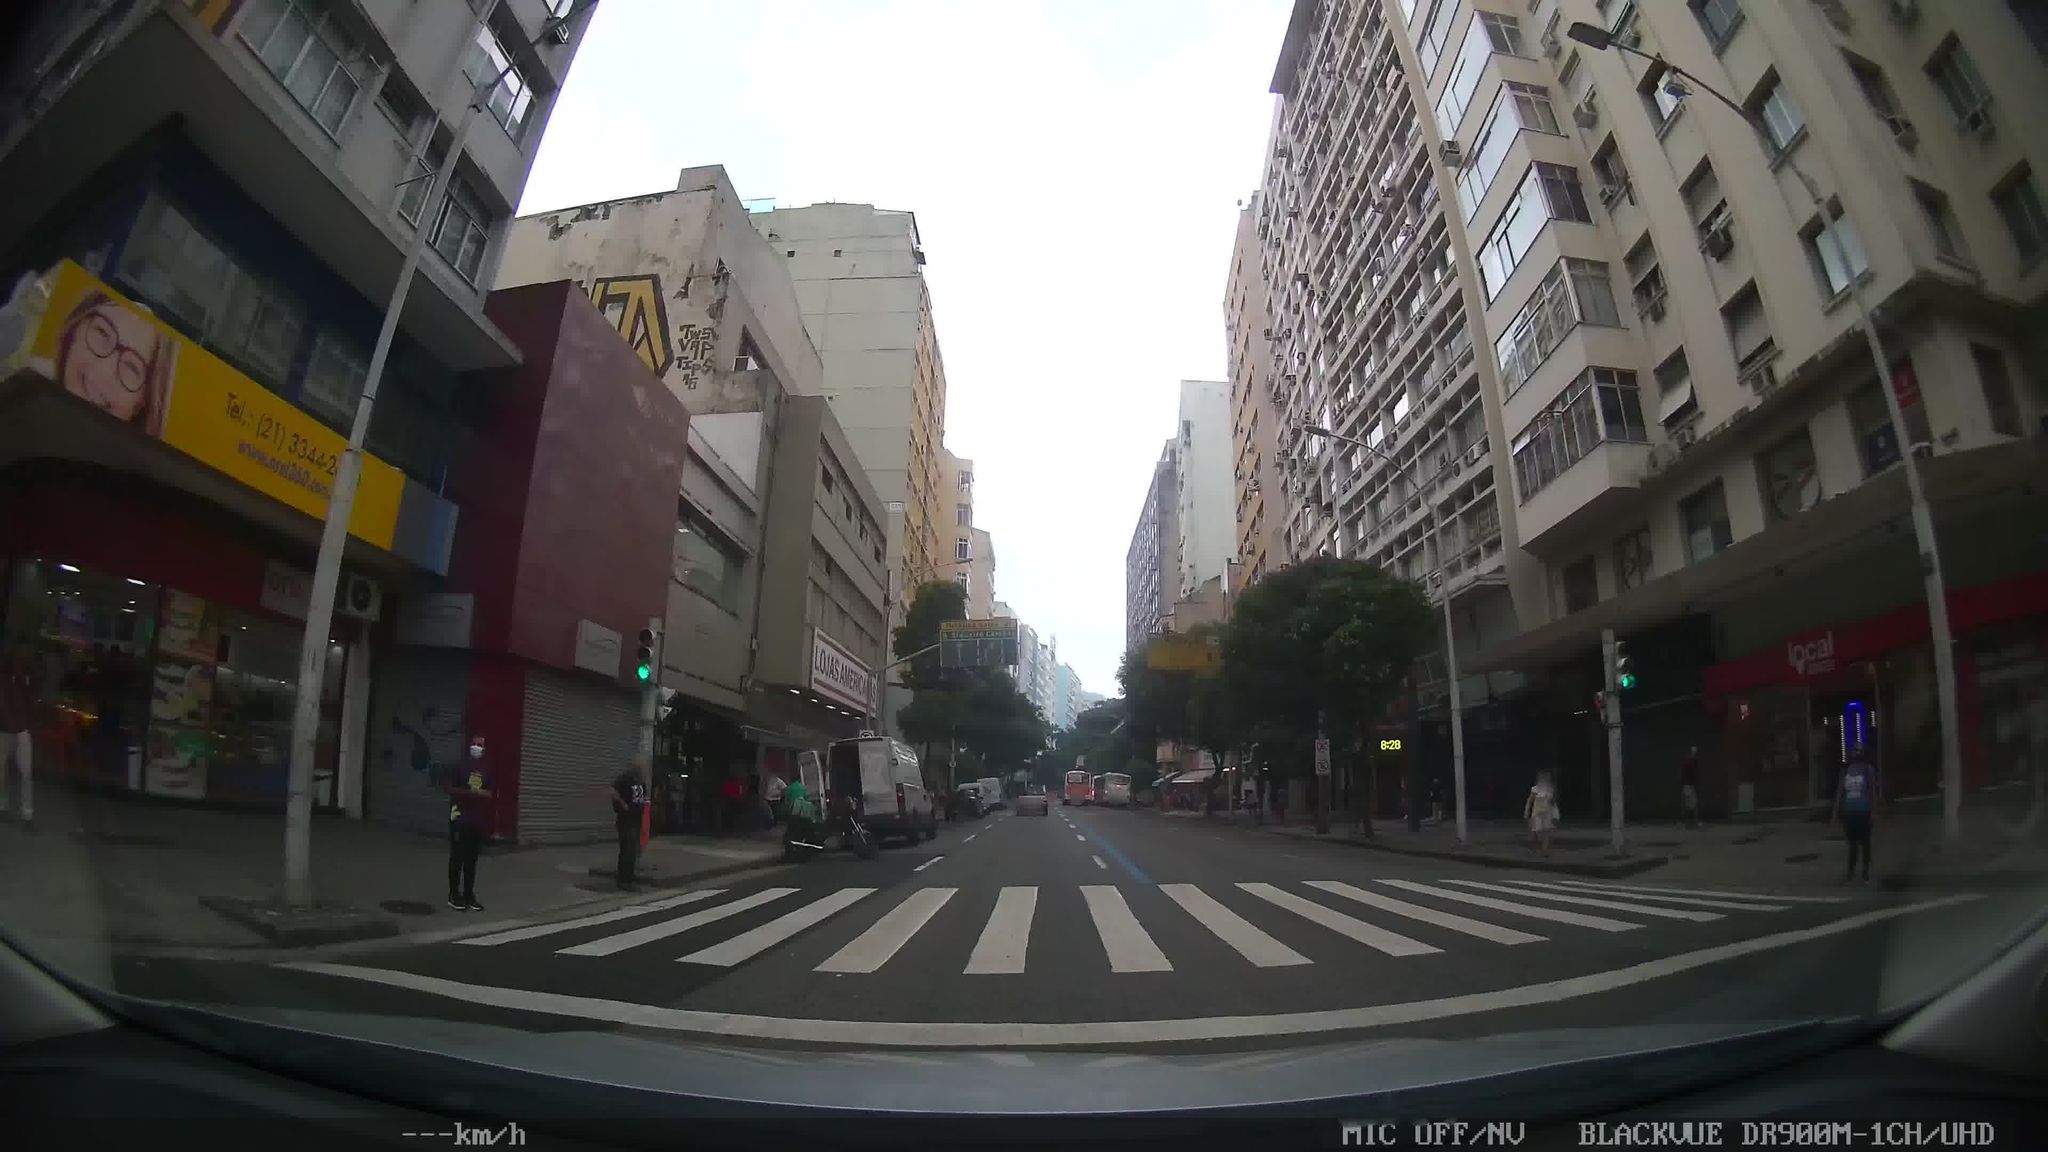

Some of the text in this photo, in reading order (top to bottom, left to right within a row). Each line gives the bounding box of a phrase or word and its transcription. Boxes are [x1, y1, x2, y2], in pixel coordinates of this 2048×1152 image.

[256, 413, 286, 451] (21)
[814, 645, 839, 682] LOJAS
[1788, 631, 1834, 668] local
[1380, 739, 1401, 751] 8:28
